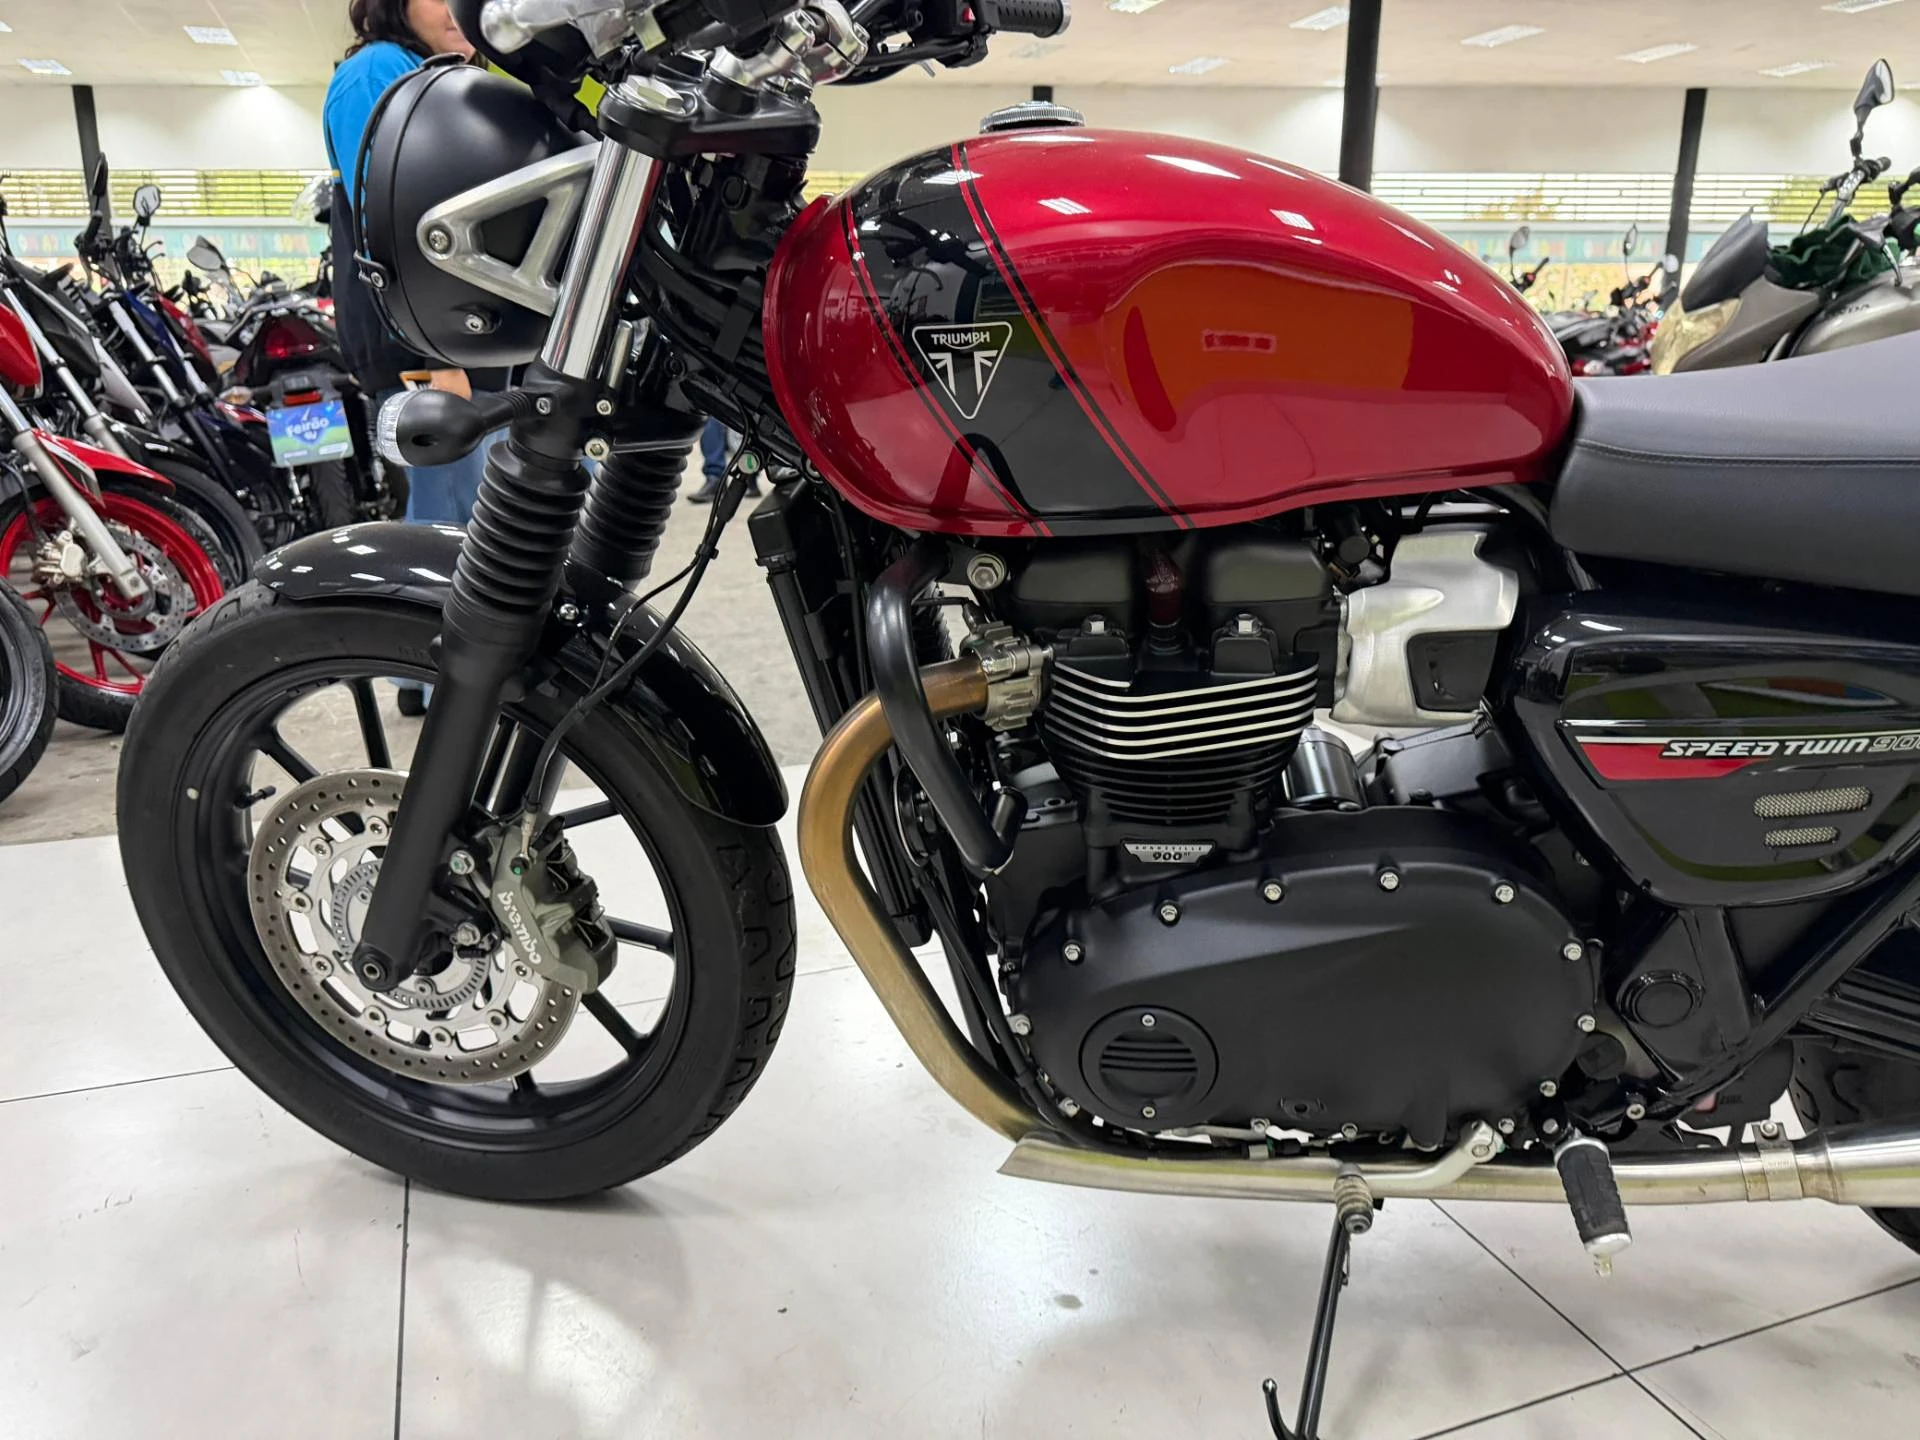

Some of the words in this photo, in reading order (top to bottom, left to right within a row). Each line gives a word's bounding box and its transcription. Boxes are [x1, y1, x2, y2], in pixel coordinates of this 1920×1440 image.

[931, 331, 990, 347] TRIUMPH
[286, 416, 329, 438] Feirão
[1661, 741, 1779, 757] SPEED
[1783, 738, 1869, 755] TWIN
[1868, 735, 1920, 752] 90
[1152, 851, 1182, 861] 900
[497, 889, 542, 965] brembo
